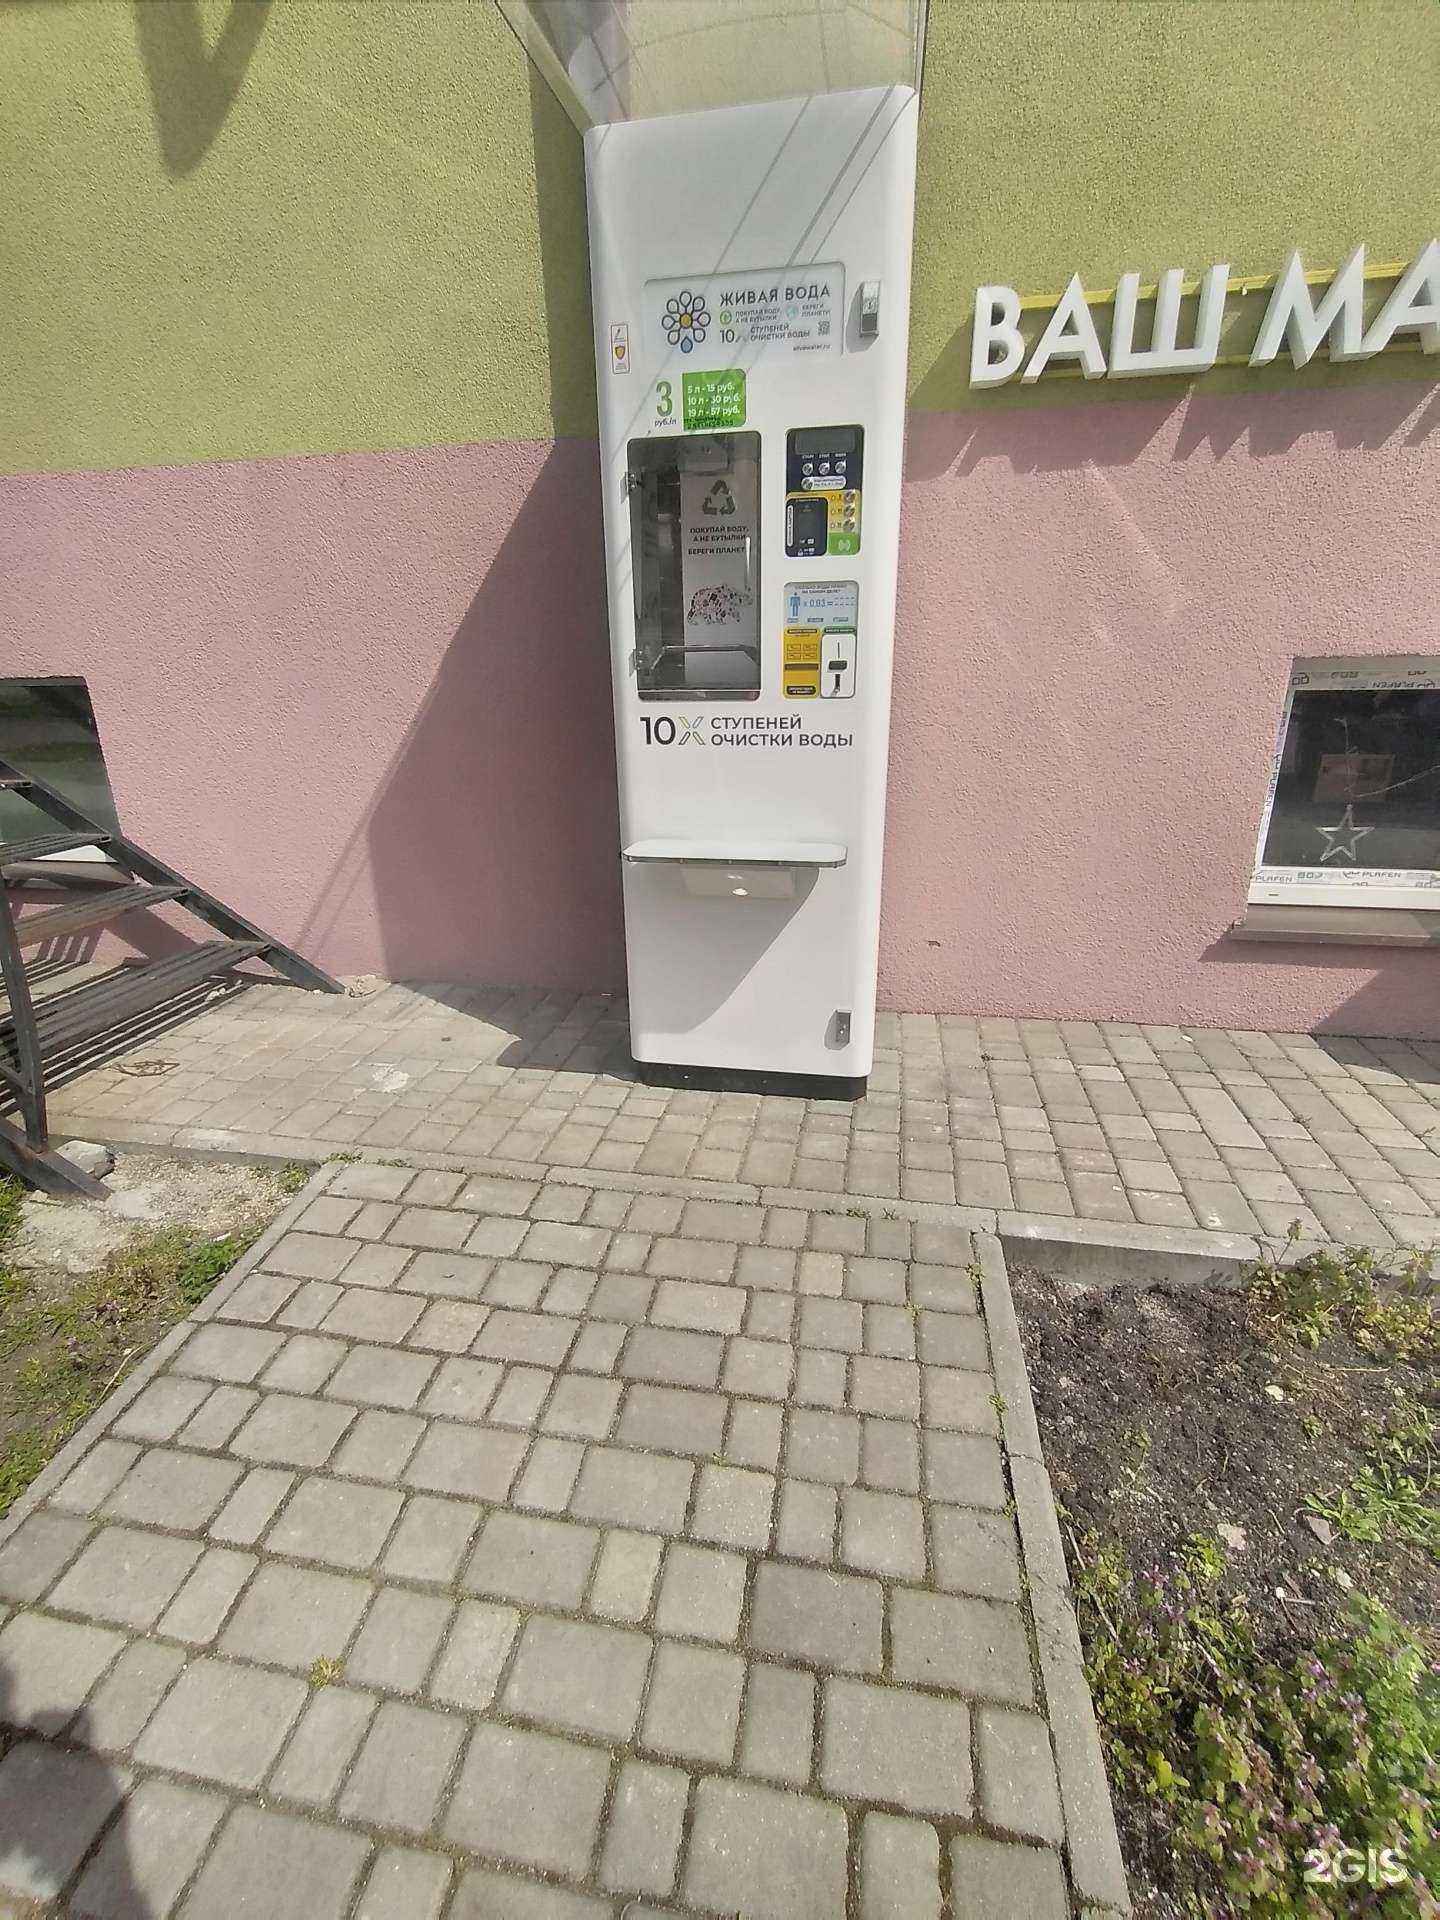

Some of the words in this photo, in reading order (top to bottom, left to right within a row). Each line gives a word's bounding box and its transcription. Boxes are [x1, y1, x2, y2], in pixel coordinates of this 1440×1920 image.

[720, 288, 778, 307] ЖИВАЯ
[785, 284, 830, 301] ВОДА
[750, 322, 789, 334] СТУПЕНЕЙ
[969, 264, 1230, 389] ВАШ
[687, 385, 693, 394] 5
[706, 384, 715, 392] 15
[717, 382, 736, 393] руб.
[656, 381, 673, 417] 3
[688, 397, 697, 406] 10
[711, 395, 721, 404] 30
[723, 393, 742, 404] руб.
[688, 409, 697, 417] 19
[710, 407, 720, 416] 57
[722, 405, 741, 416] руб.
[690, 525, 725, 533] ПОКУПАЙ
[710, 714, 802, 730] СТУПЕНЕЙ
[710, 733, 793, 747] ОЧИСТКИ
[799, 733, 853, 749] ВОДЫ
